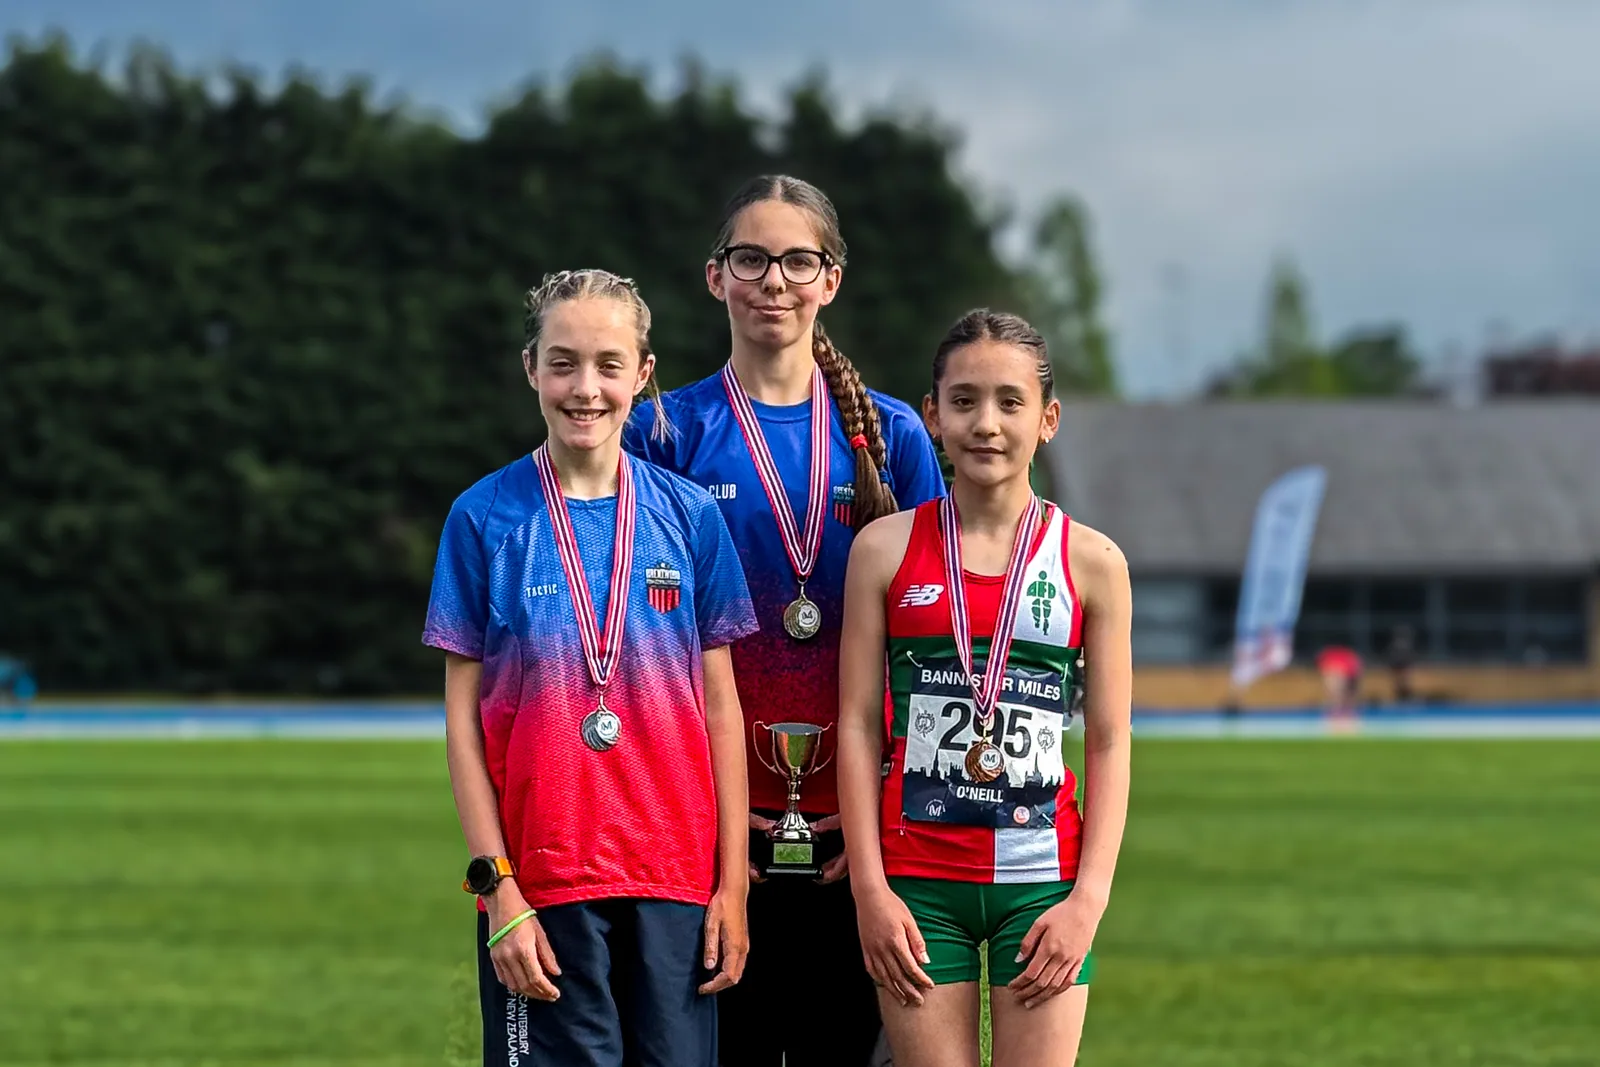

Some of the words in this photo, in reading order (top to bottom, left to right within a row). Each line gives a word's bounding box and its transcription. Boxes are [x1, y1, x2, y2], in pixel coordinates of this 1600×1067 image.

[708, 483, 737, 499] CLUB
[525, 583, 558, 598] TACTIC
[921, 669, 1014, 691] BANNISR
[1017, 679, 1061, 701] MILES
[938, 701, 1033, 758] 295
[956, 785, 1004, 803] O'NEILL
[506, 998, 517, 1021] NEW
[507, 1022, 519, 1067] ZEALAND
